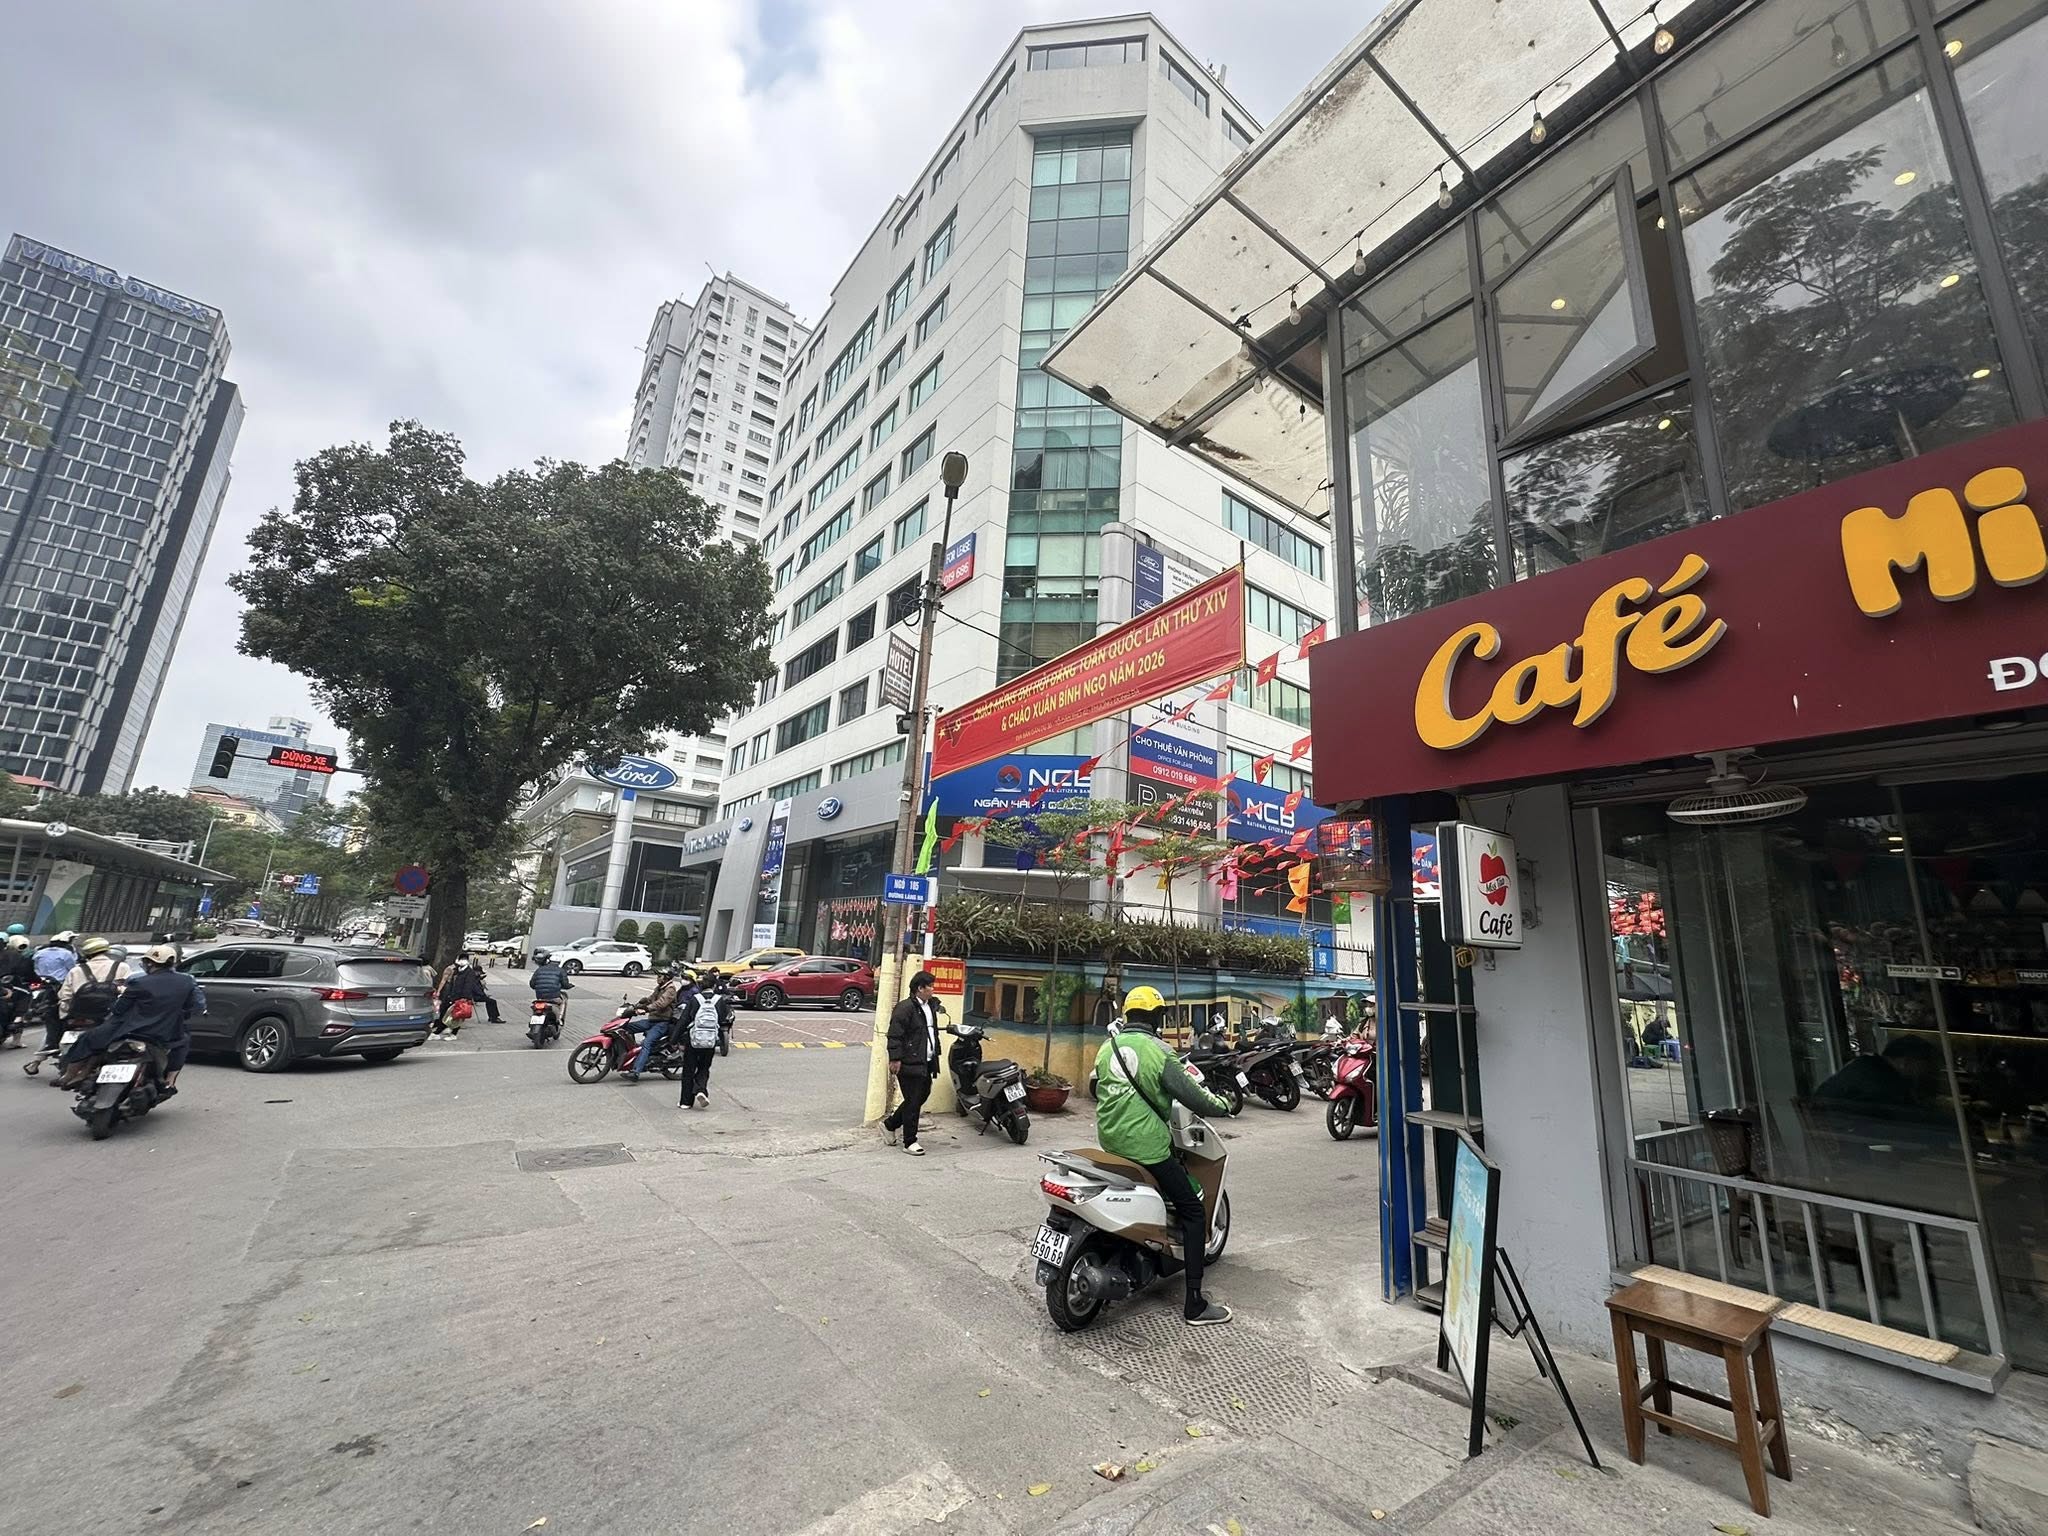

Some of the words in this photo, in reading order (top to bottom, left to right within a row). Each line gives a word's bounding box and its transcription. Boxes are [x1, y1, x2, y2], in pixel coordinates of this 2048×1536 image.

[21, 238, 210, 322] VINACONEX
[945, 551, 955, 565] FOR
[956, 539, 972, 559] LEASE
[1079, 646, 1106, 672] TOÀN
[1108, 629, 1142, 658] QUỐC
[1145, 615, 1170, 644] LẦN
[1173, 597, 1202, 629] THỨ
[1204, 588, 1229, 618] XIV
[889, 648, 911, 679] HOTEL
[1415, 553, 1727, 749] Café
[1987, 651, 2048, 691] Đ
[1001, 717, 1007, 732] &
[1008, 705, 1030, 729] CHÀO
[1033, 694, 1057, 718] XUÂN
[1059, 684, 1081, 708] BÍNH
[1083, 674, 1107, 697] NGỌ
[1109, 661, 1135, 686] NĂM
[1138, 649, 1165, 676] 2026
[281, 750, 312, 763] DỪNG
[313, 756, 327, 766] XE
[1135, 735, 1153, 747] CHO
[1153, 741, 1173, 754] THUÊ
[1173, 744, 1188, 758] VĂN
[1189, 751, 1213, 765] PHÒNG
[605, 759, 660, 784] Ford
[1152, 766, 1170, 777] 0912
[1171, 770, 1183, 781] 019
[1184, 773, 1197, 785] 686
[974, 798, 1008, 807] NGÂN
[1247, 797, 1295, 828] NCB
[1480, 911, 1513, 938] Café
[1040, 1228, 1065, 1249] 22-B1
[1034, 1241, 1063, 1265] 590.68
